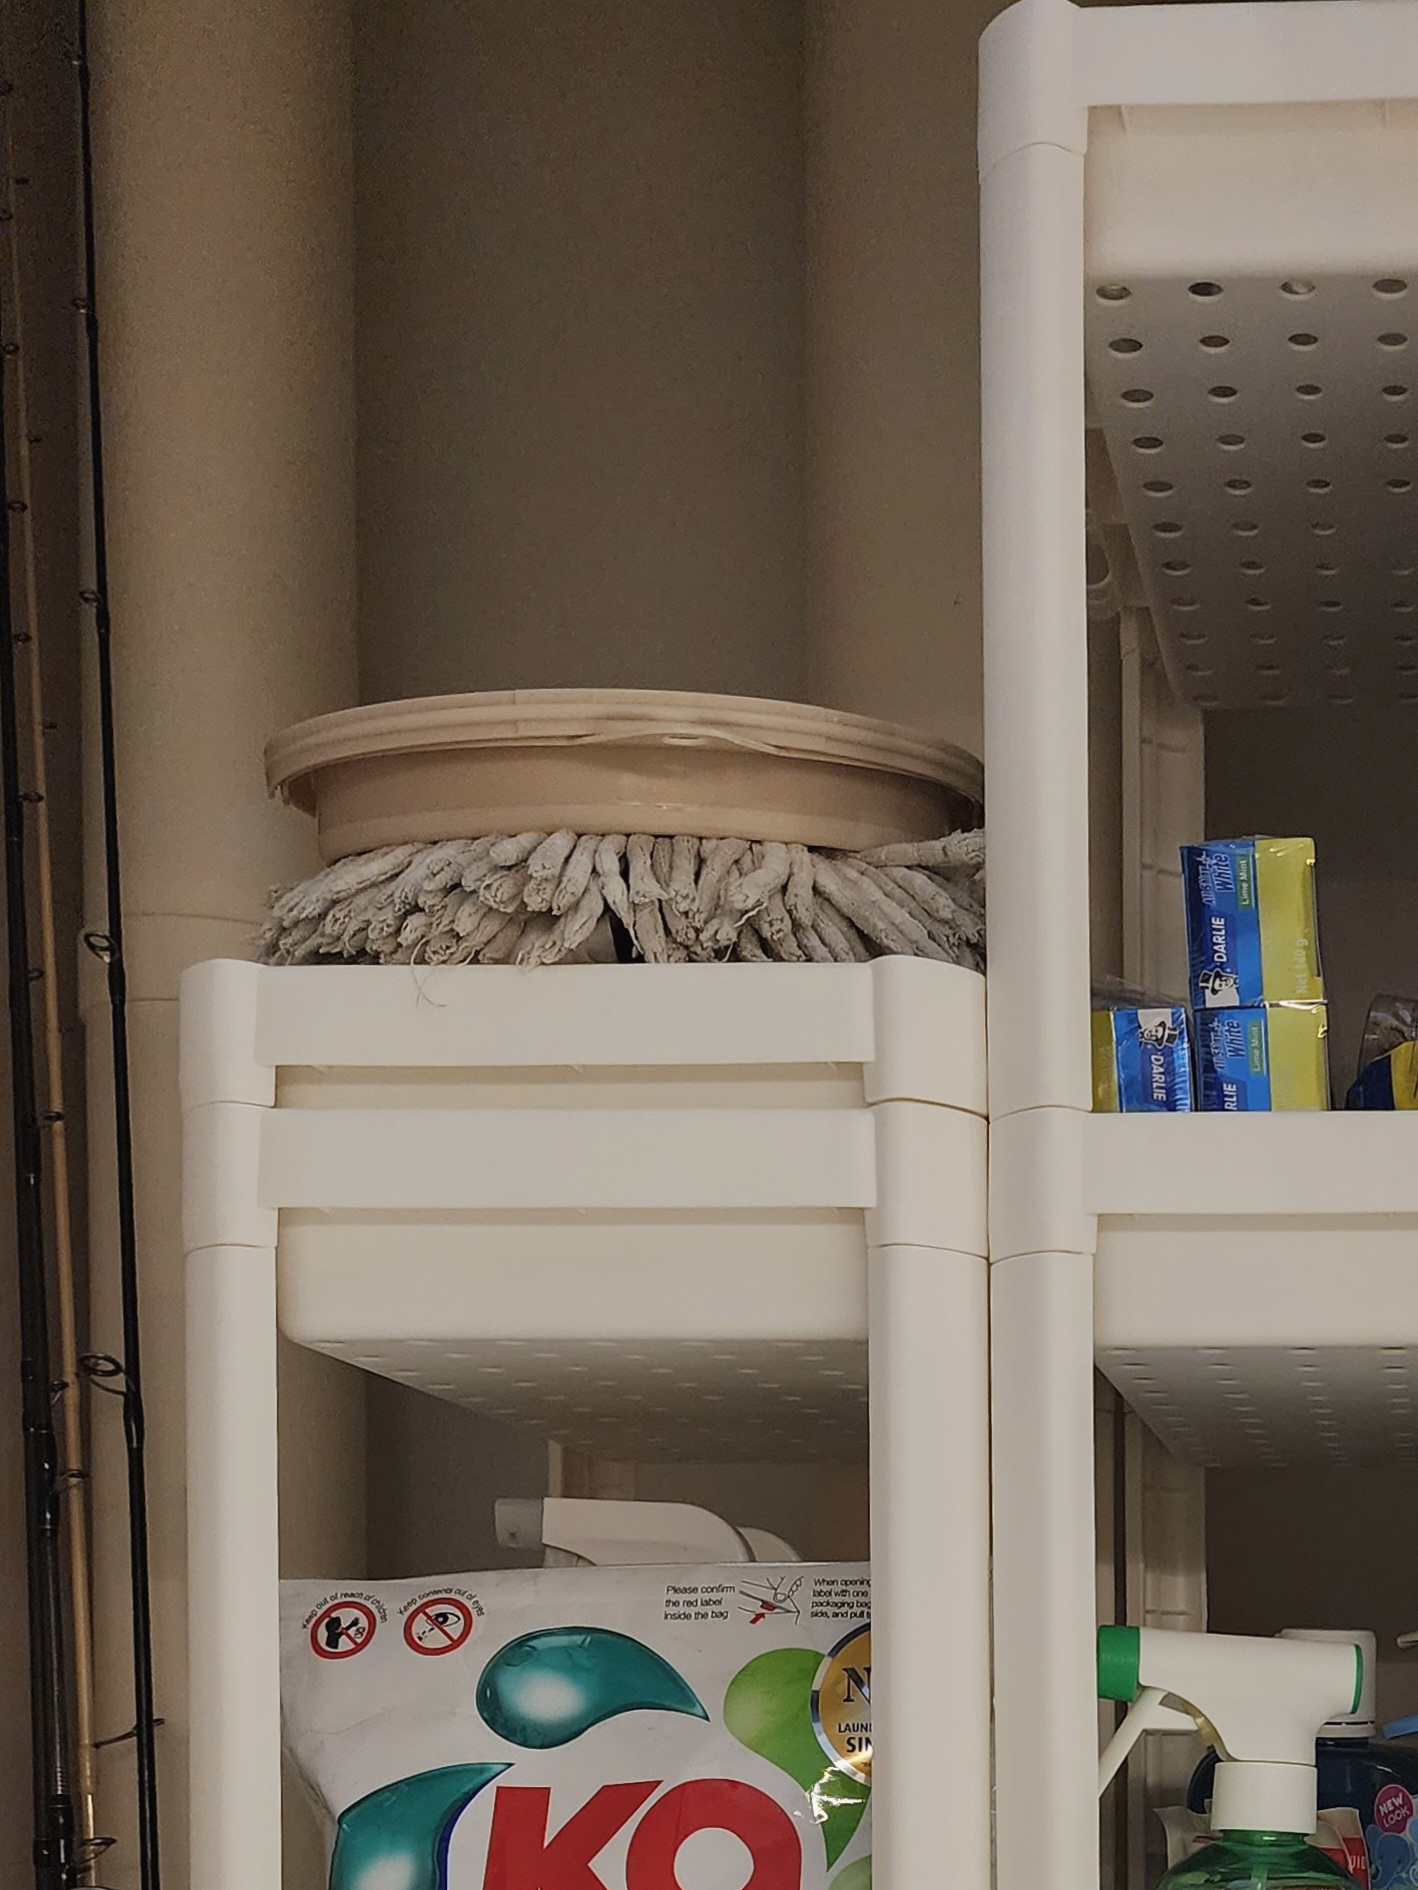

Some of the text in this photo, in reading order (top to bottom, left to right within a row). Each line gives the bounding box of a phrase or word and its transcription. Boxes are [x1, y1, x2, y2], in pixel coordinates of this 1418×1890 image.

[1238, 880, 1250, 905] Lime
[1211, 916, 1227, 962] DARLIE
[1151, 1054, 1166, 1101] DARLIE
[1223, 1082, 1238, 1111] RLIE
[814, 1577, 839, 1587] When
[666, 1584, 736, 1595] Please confirm
[812, 1589, 869, 1598] label with one
[665, 1597, 723, 1608] the red label
[811, 1600, 854, 1610] packaging
[694, 1610, 709, 1620] the
[710, 1610, 729, 1621] bag
[831, 1610, 849, 1619] and
[849, 1610, 865, 1620] pull
[842, 1666, 871, 1705] N
[838, 1722, 872, 1734] LAUN
[846, 1737, 873, 1753] SIN
[1378, 1791, 1404, 1817] NEW
[1382, 1806, 1411, 1828] LOOK
